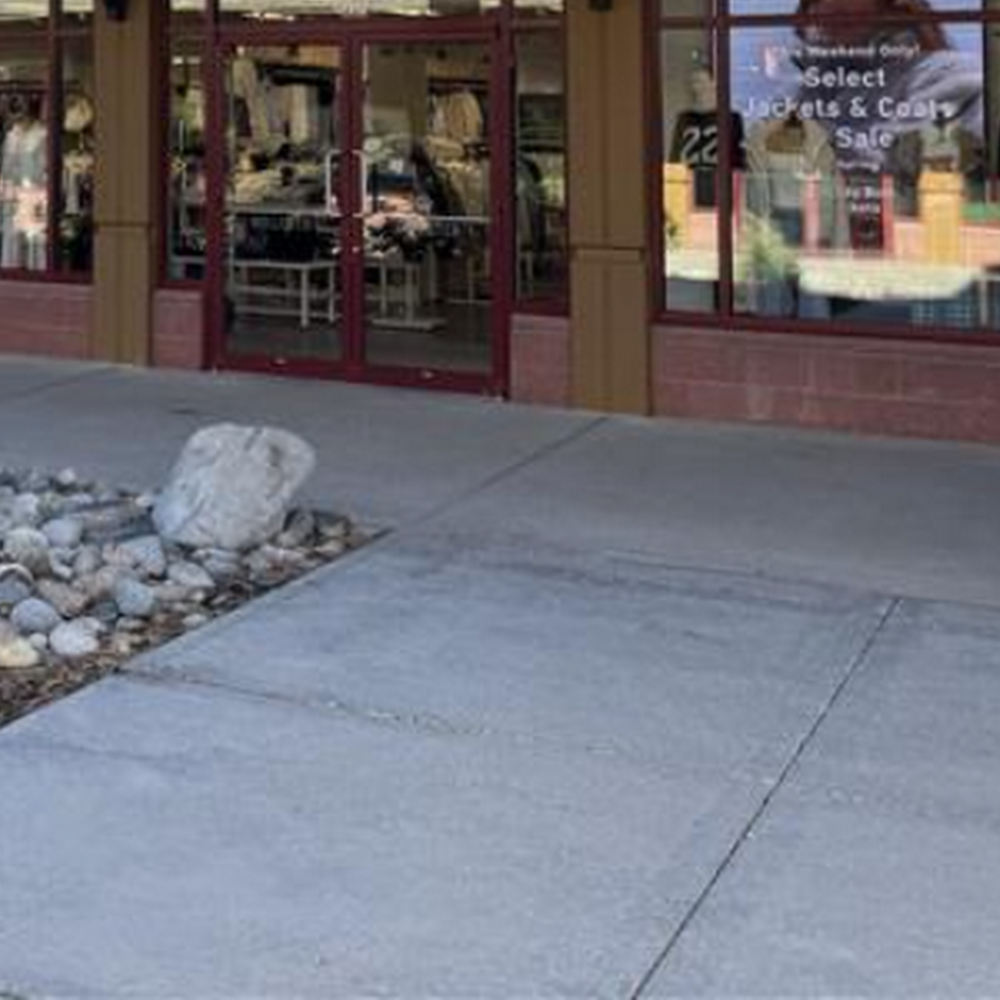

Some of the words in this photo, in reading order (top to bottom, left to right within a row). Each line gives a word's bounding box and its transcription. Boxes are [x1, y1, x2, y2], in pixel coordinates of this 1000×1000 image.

[802, 66, 887, 88] Select
[742, 96, 841, 119] Jackets
[849, 96, 868, 118] &
[680, 125, 719, 164] 22
[835, 126, 895, 149] Sale
